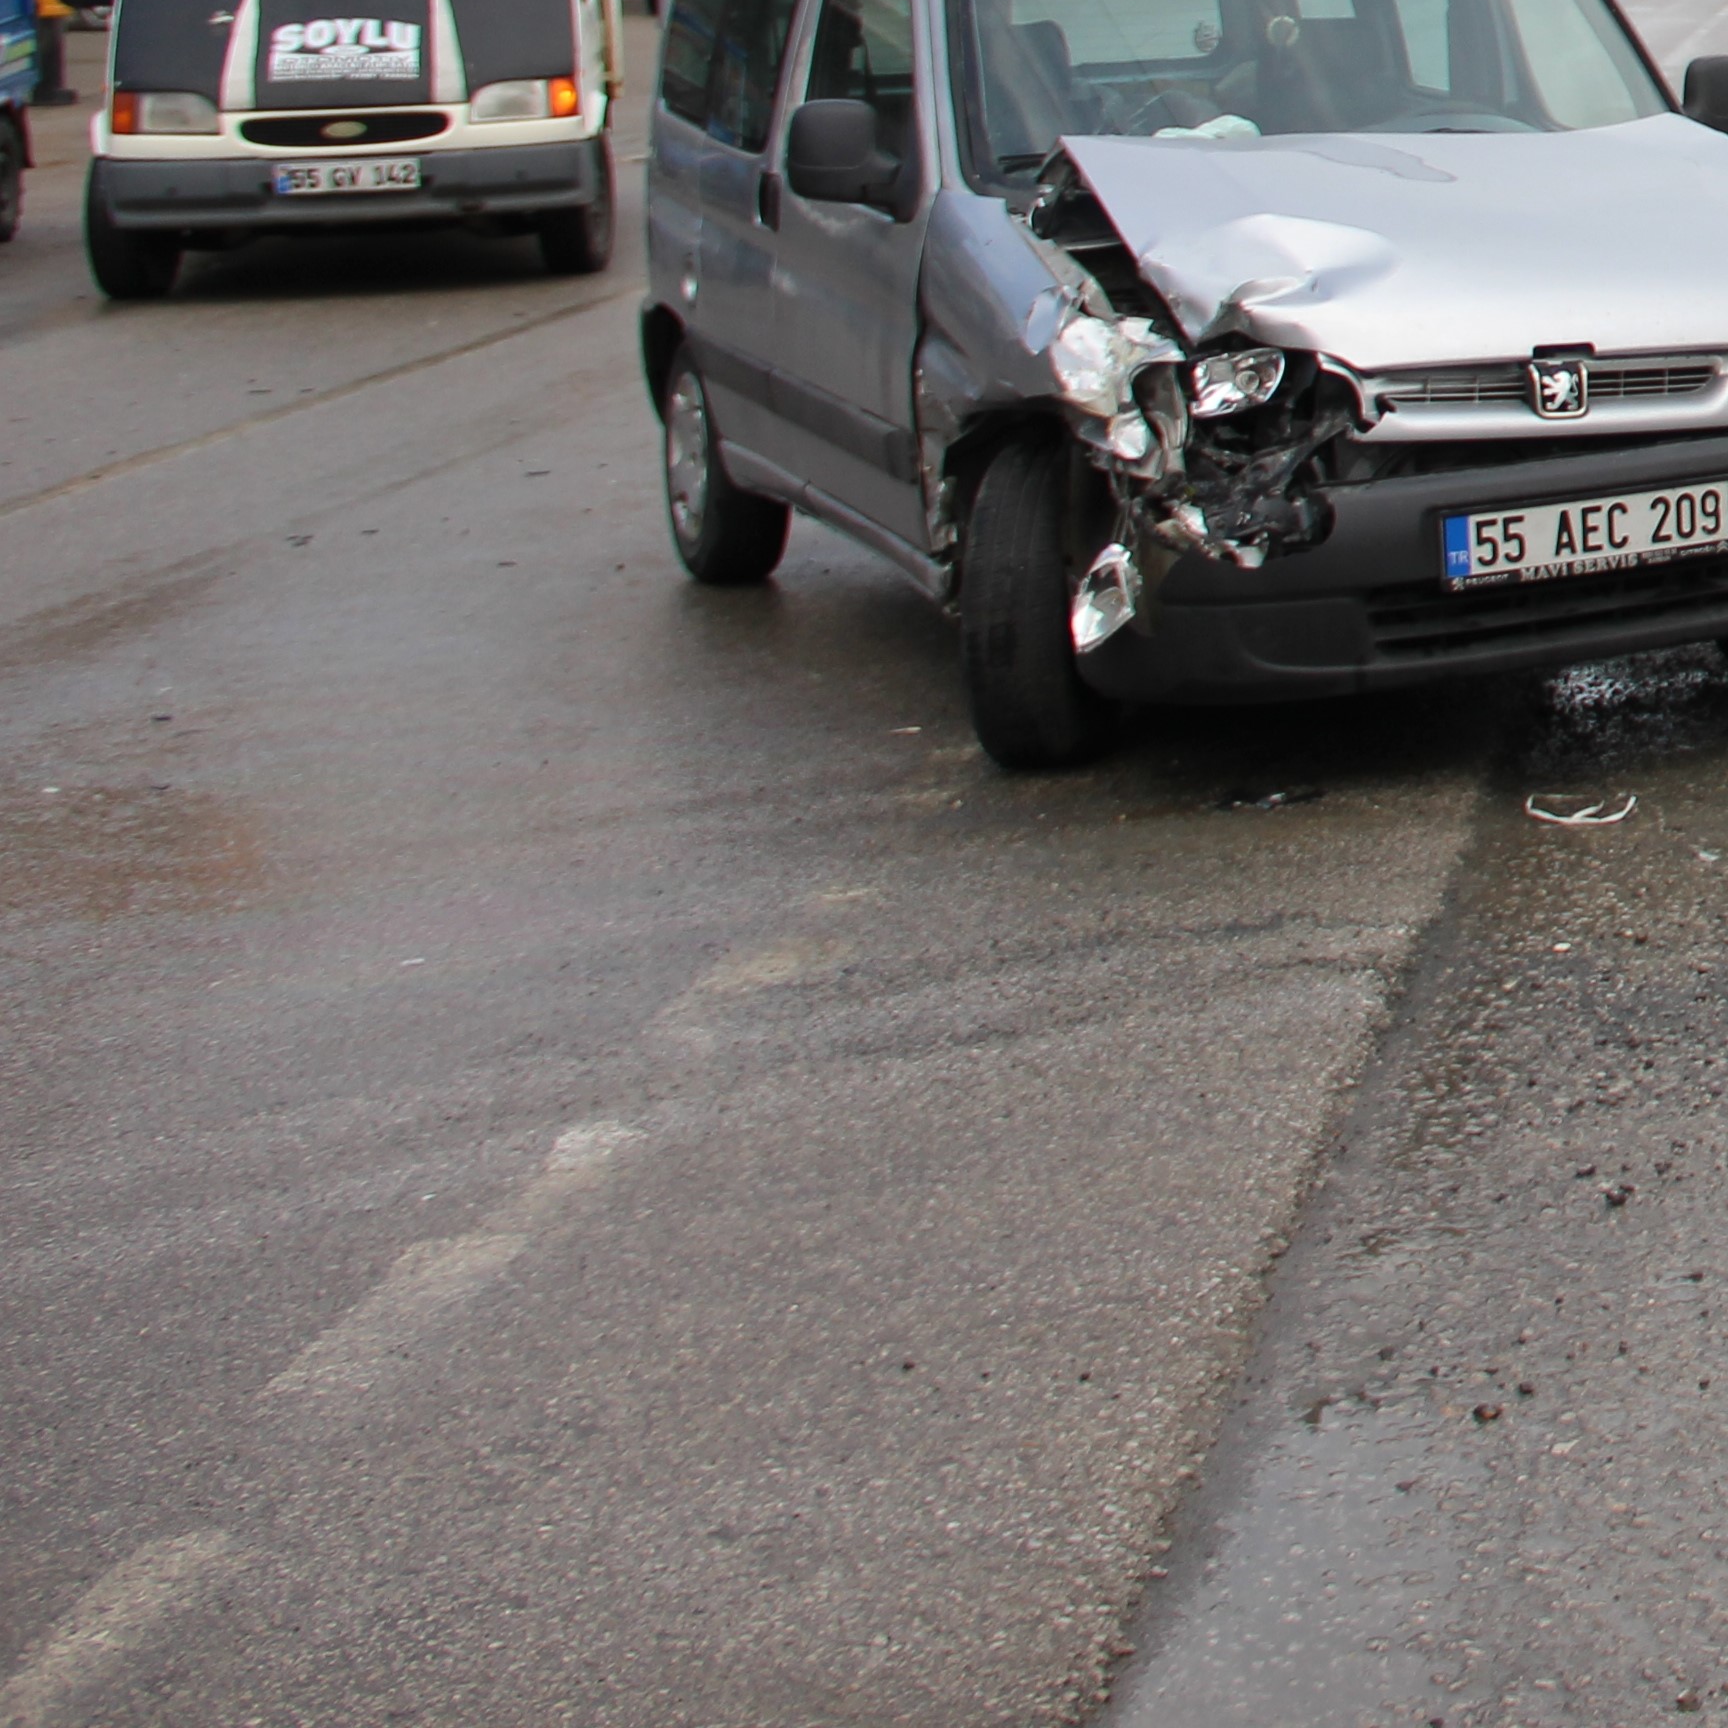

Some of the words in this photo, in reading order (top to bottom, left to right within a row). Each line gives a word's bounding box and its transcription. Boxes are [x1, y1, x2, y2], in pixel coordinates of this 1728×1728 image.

[270, 18, 421, 52] SOYLU
[290, 169, 320, 189] 55
[373, 163, 417, 186] 142
[1449, 550, 1469, 565] TR
[1475, 514, 1527, 566] 55
[1555, 501, 1630, 557] AEC
[1649, 488, 1721, 543] 209
[1466, 573, 1509, 586] PEUGEOT
